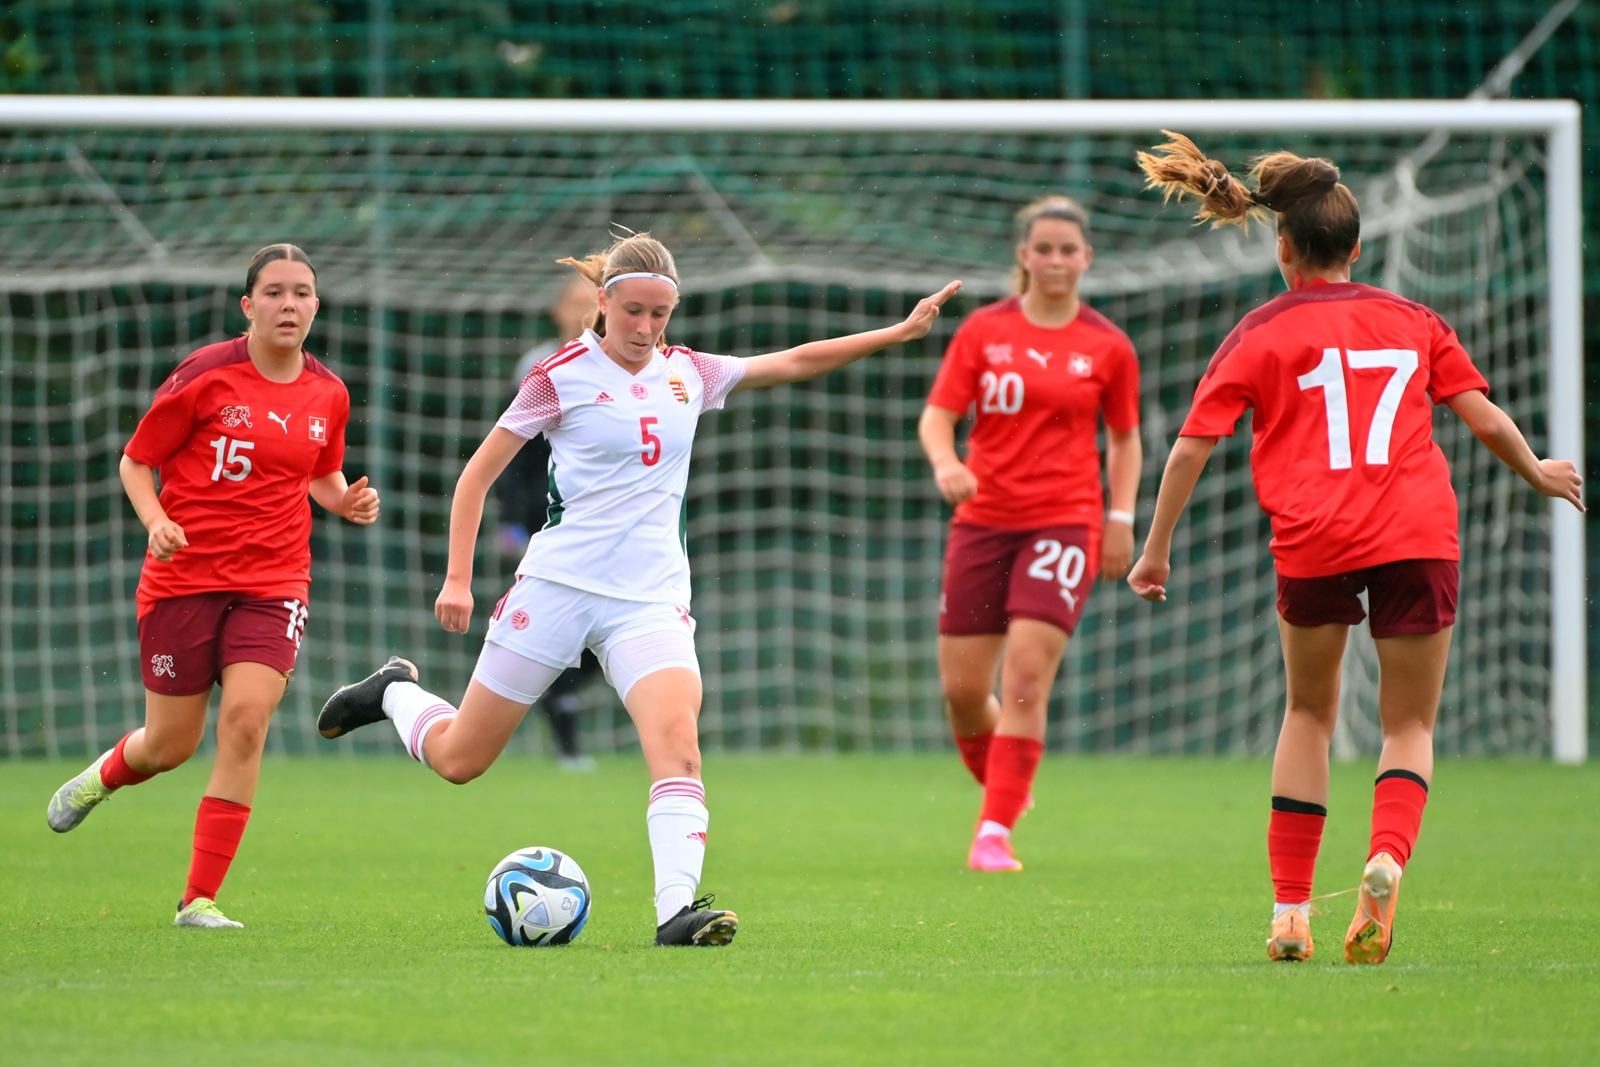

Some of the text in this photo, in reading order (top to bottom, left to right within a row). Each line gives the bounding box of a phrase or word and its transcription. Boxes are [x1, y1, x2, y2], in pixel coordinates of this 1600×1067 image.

[980, 371, 1024, 415] 20
[1297, 347, 1419, 470] 17
[210, 435, 255, 482] 15
[640, 416, 662, 467] 5
[1028, 539, 1086, 589] 20
